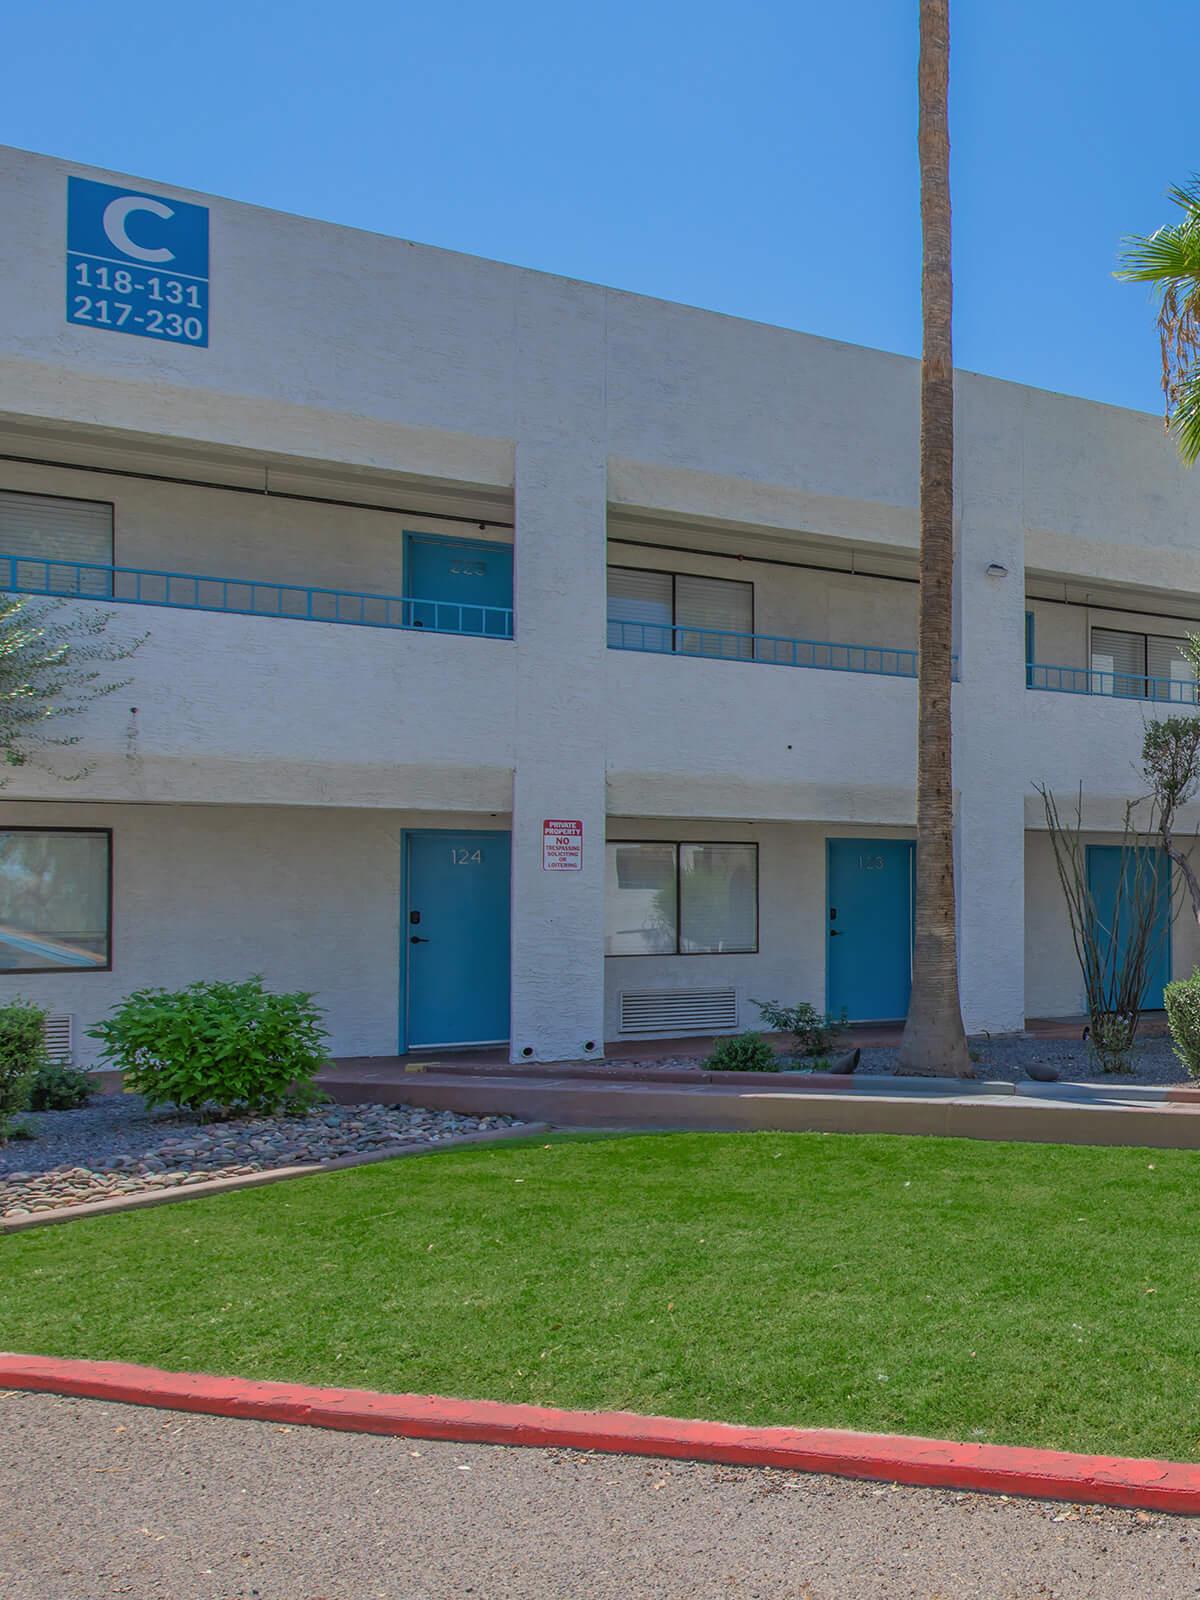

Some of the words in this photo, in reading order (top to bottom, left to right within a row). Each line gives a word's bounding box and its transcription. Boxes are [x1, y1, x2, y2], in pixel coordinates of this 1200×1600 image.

[103, 196, 176, 263] C
[75, 262, 202, 309] 118-131
[73, 295, 203, 340] 217-230
[451, 849, 481, 865] 124
[556, 837, 570, 845] NO
